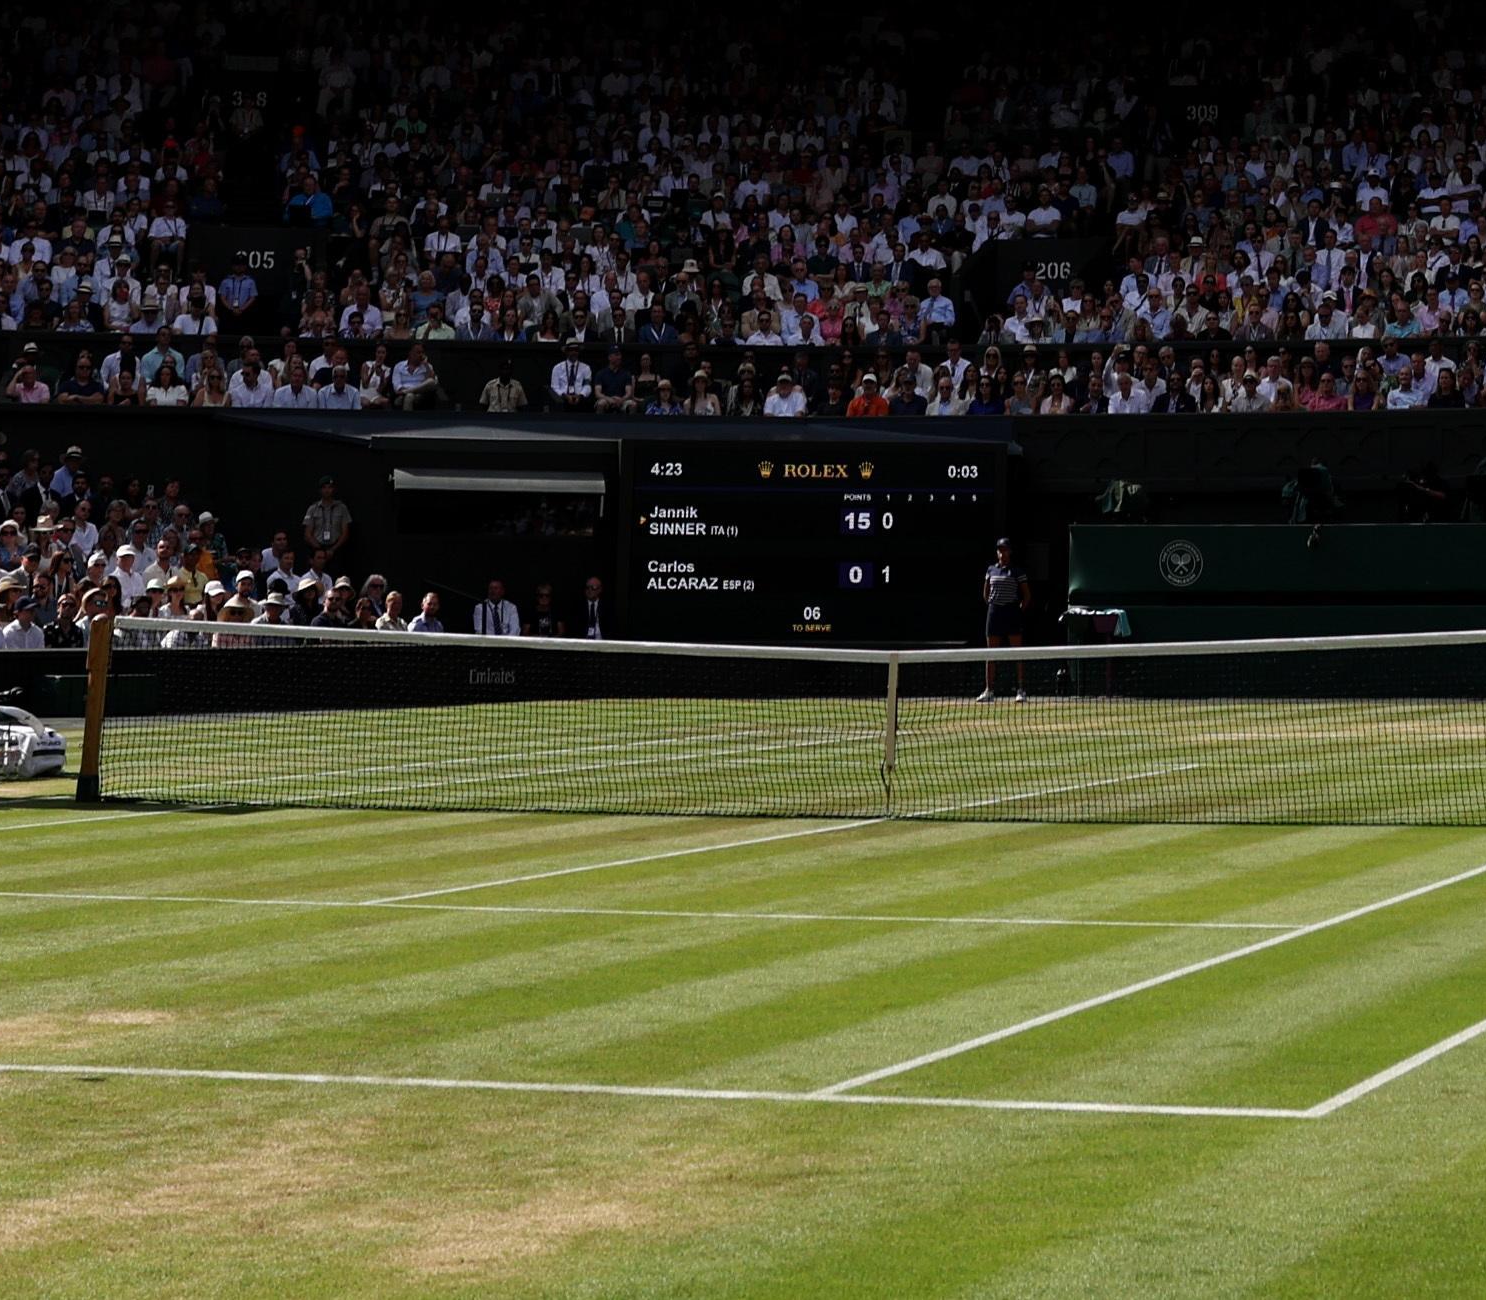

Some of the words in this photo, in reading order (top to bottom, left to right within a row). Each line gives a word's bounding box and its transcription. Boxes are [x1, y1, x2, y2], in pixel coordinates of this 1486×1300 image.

[232, 90, 267, 107] 38
[1186, 104, 1219, 122] 309
[1035, 261, 1071, 280] 206
[650, 462, 683, 476] 4:23
[784, 464, 848, 478] ROLEX
[947, 465, 979, 479] 0:03
[843, 493, 872, 502] POINTS
[649, 505, 698, 519] Jannik
[649, 522, 707, 535] SINNER
[710, 525, 725, 536] ITA
[726, 525, 739, 537] (1)
[844, 512, 871, 530] 15
[882, 511, 894, 530] 0
[647, 560, 695, 573] Carlos
[646, 577, 719, 590] ALCARAZ
[722, 579, 742, 590] ESP
[742, 579, 755, 592] (2)
[848, 565, 863, 584] 0
[881, 565, 890, 583] 1
[803, 606, 821, 621] 06
[792, 624, 803, 633] TO
[804, 623, 832, 633] SERVE
